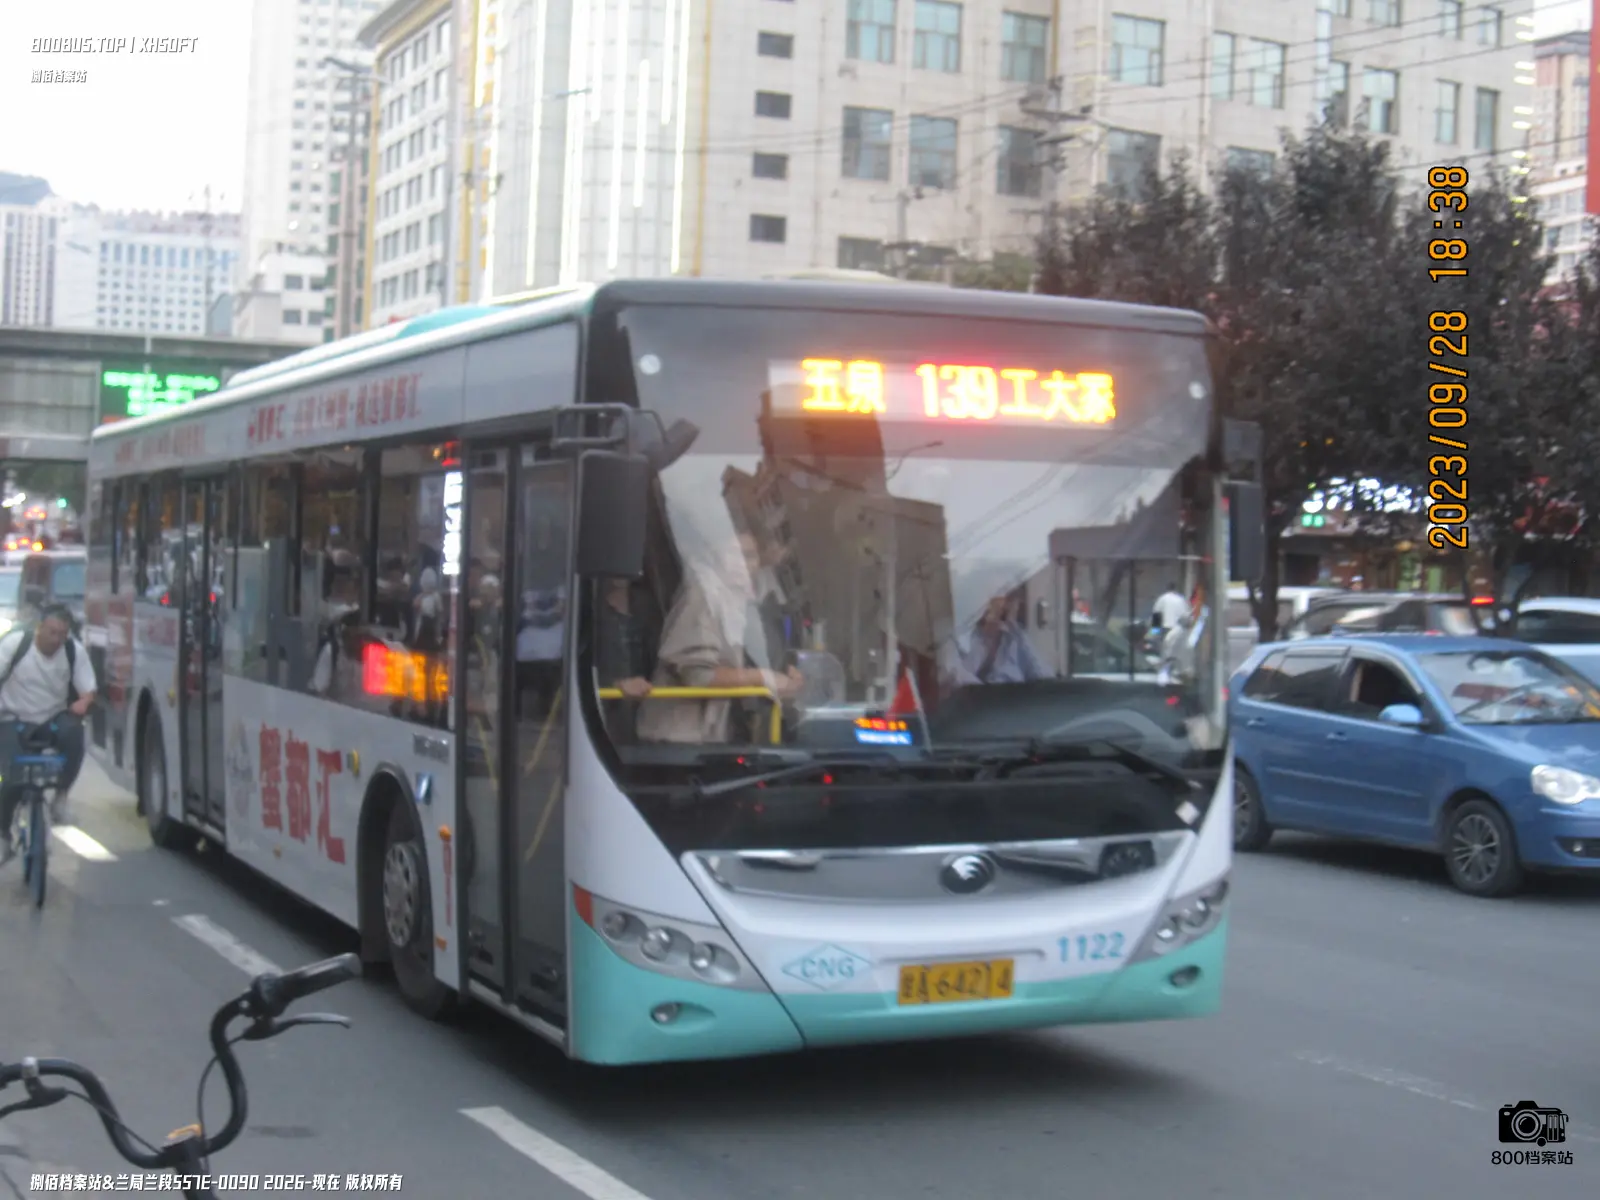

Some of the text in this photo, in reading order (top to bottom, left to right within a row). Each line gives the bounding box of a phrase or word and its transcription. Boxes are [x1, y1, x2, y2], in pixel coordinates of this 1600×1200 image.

[916, 363, 998, 419] 139
[1057, 932, 1125, 963] 1122
[801, 957, 855, 980] CNG
